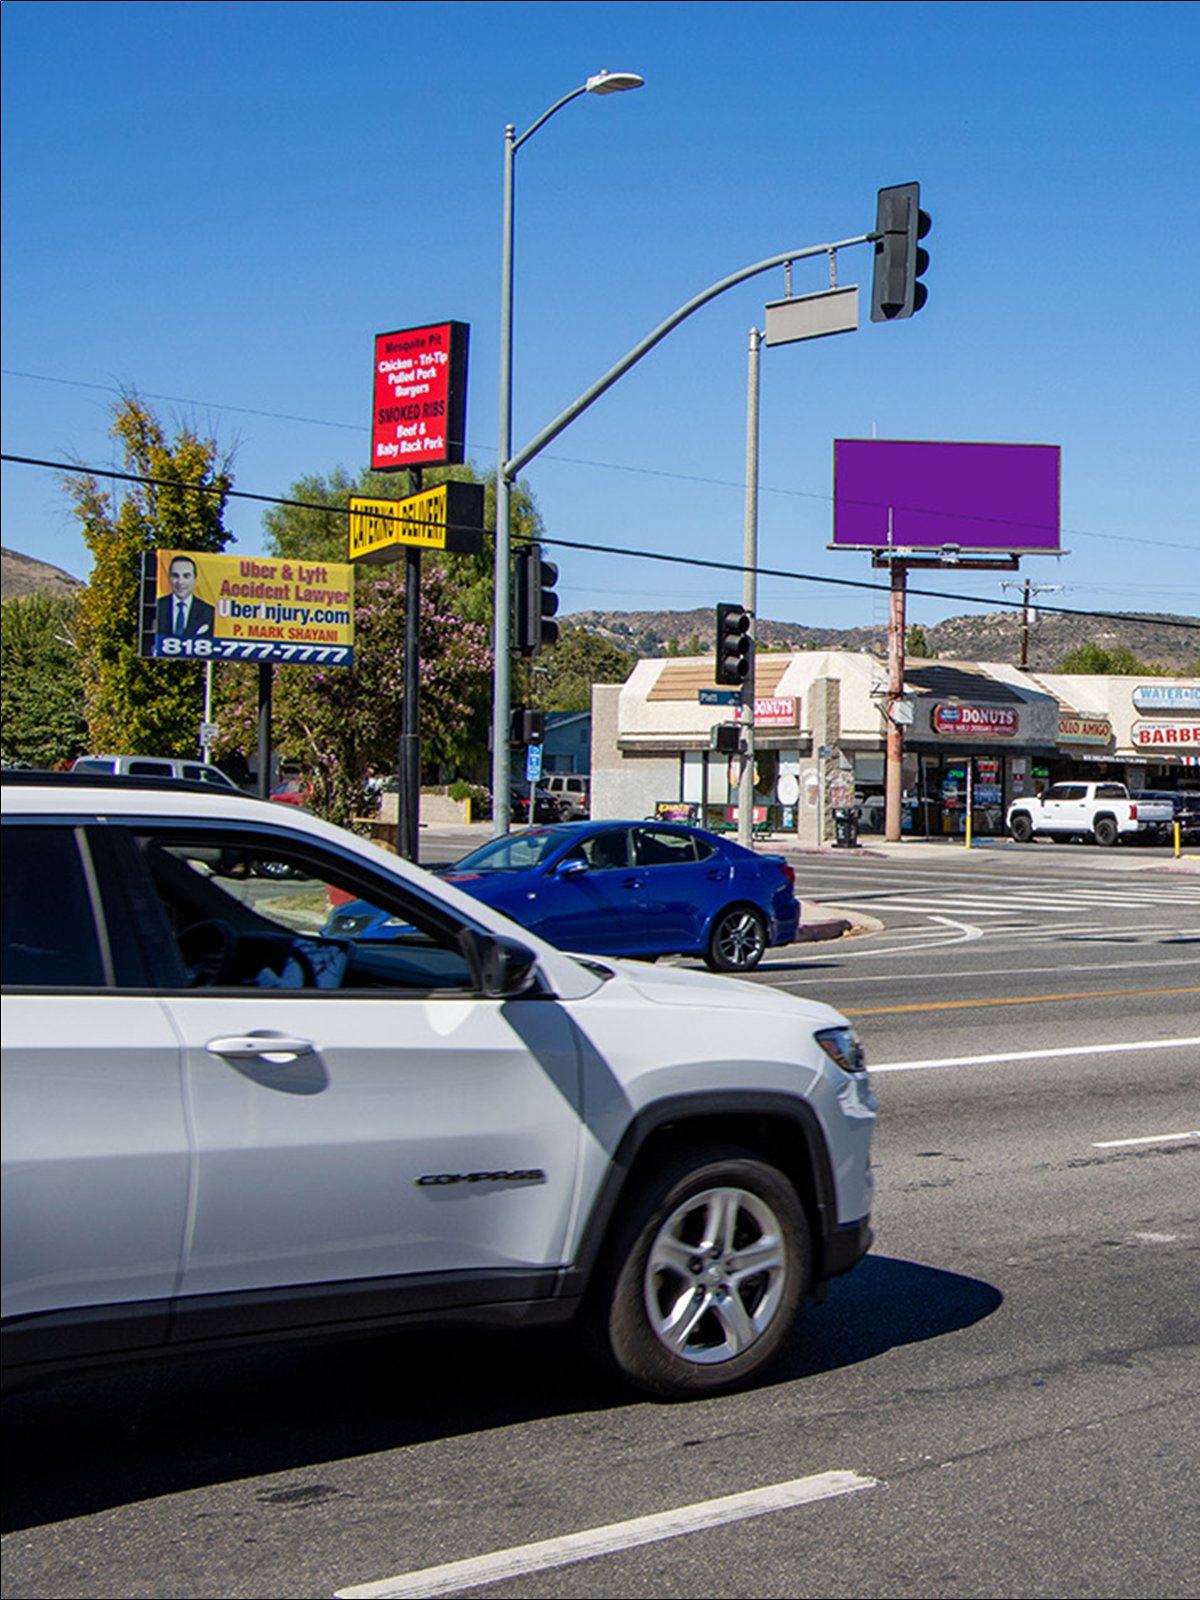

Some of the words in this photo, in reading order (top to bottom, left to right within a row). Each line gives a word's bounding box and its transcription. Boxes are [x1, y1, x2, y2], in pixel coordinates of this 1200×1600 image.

[385, 338, 425, 353] Mesquite
[428, 334, 442, 347] Pit
[378, 359, 412, 372] Chicken
[419, 351, 448, 365] Tri-Tip
[388, 370, 414, 384] Pulled
[416, 367, 437, 380] Pork
[395, 384, 429, 397] Burgers
[378, 404, 420, 423] SMOKED
[422, 400, 445, 418] RIBS
[396, 423, 417, 437] Beef
[419, 422, 426, 435] &
[377, 443, 399, 457] Baby
[400, 439, 421, 453] Back
[423, 436, 444, 450] Pork
[401, 493, 447, 540] DELIVERY
[240, 560, 278, 578] Uber
[281, 563, 293, 581] &
[297, 565, 328, 584] Lyft
[219, 579, 290, 600] Accident
[294, 585, 350, 606] Lawyer
[216, 598, 350, 625] UberInjury.com
[233, 624, 244, 637] P.
[247, 625, 285, 639] MARK
[288, 627, 338, 642] SHAYANI
[161, 637, 349, 663] 818-777-7777
[962, 709, 1013, 725] DONUTS
[1058, 721, 1080, 735] OLLO
[1082, 722, 1110, 737] AMIGO
